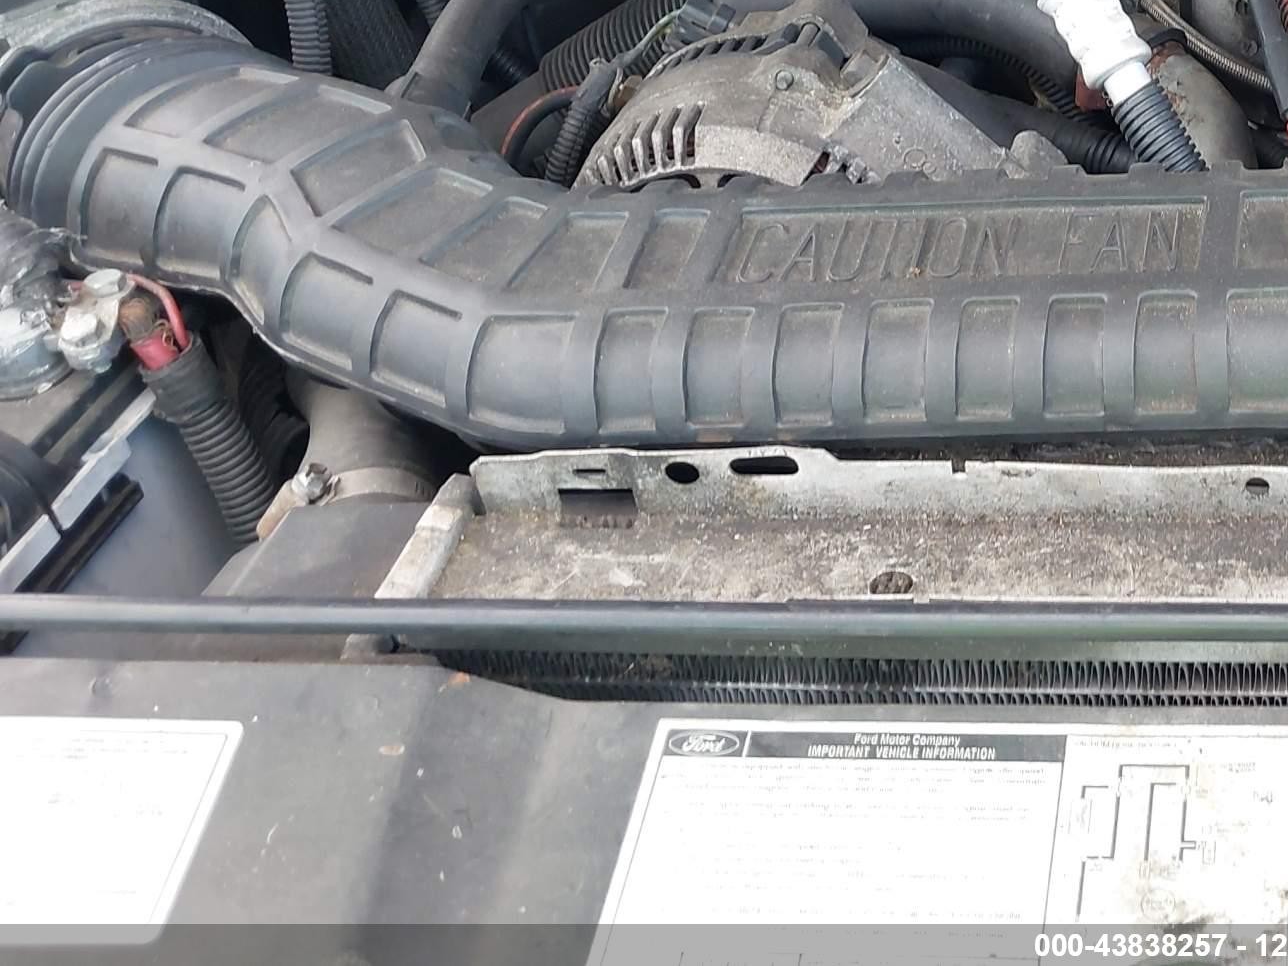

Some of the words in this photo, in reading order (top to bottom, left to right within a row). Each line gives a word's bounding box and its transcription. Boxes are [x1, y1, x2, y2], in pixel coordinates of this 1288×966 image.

[735, 216, 1020, 283] CAUTION
[1057, 210, 1180, 275] FAN
[681, 735, 724, 754] Ford
[854, 733, 878, 745] Ford
[880, 733, 911, 746] Motor
[912, 734, 960, 747] Company
[808, 745, 870, 758] IMPORTANT
[876, 746, 920, 759] VEHICLE
[922, 747, 996, 761] INFORMATION
